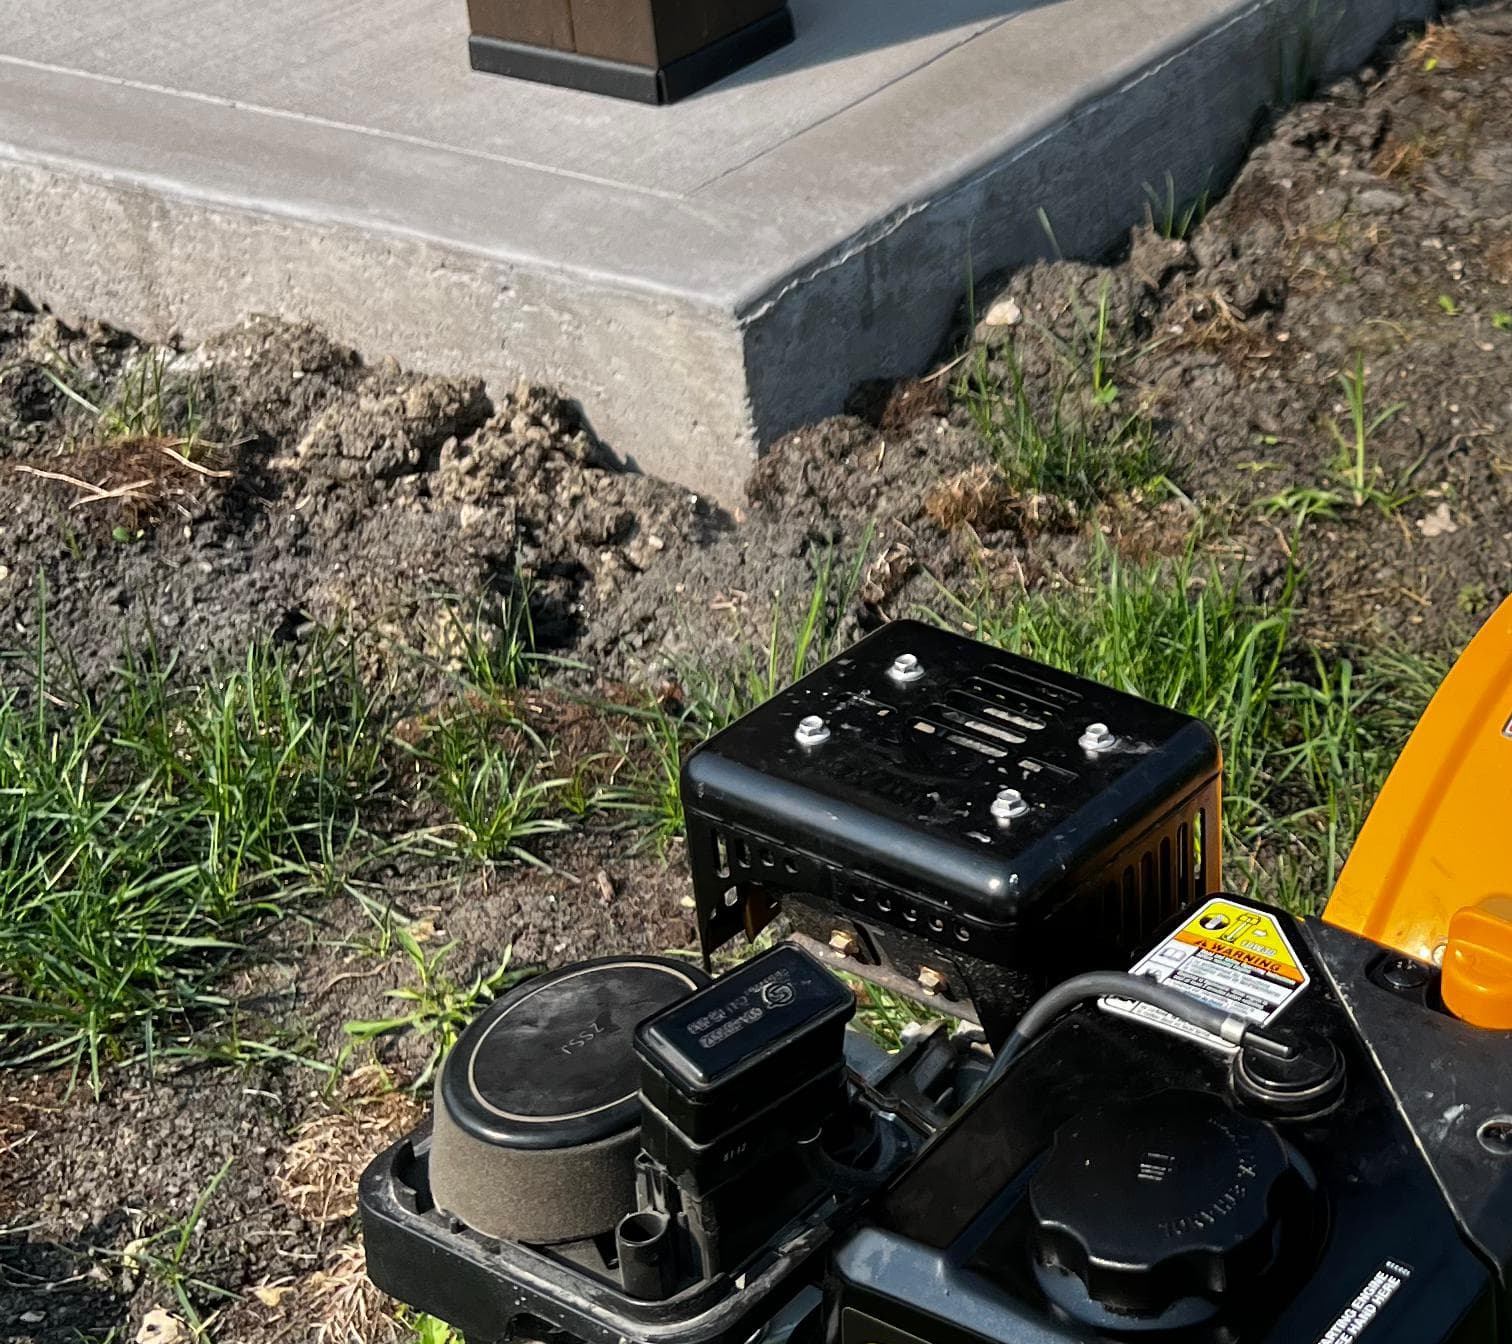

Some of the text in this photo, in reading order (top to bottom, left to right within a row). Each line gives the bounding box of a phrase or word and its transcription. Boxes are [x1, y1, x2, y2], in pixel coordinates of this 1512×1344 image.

[1212, 943, 1282, 971] WARNING
[1347, 1303, 1377, 1337] HAND
[1371, 1275, 1400, 1307] HERE
[1351, 1270, 1389, 1309] ENGINE
